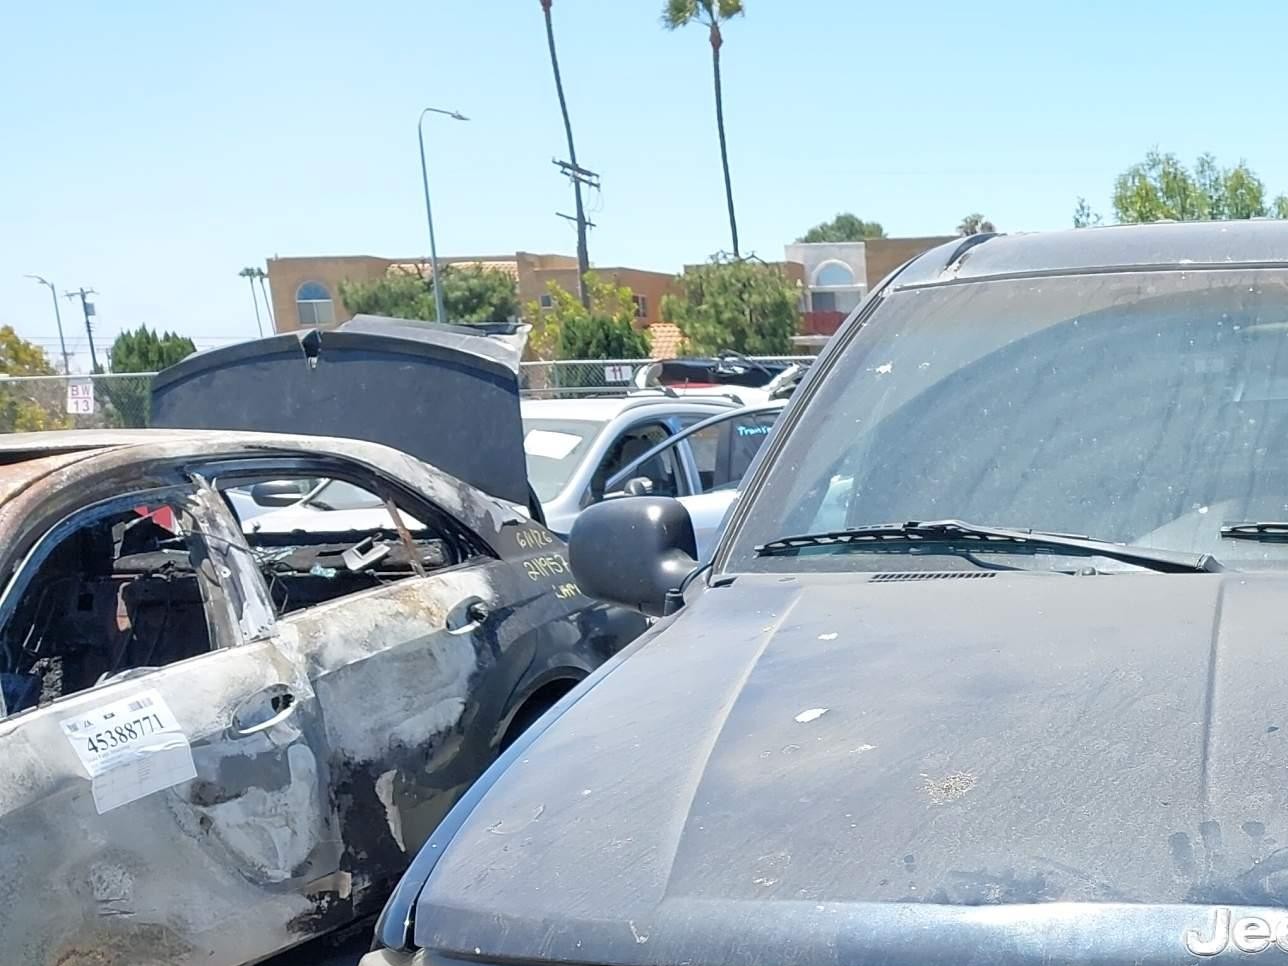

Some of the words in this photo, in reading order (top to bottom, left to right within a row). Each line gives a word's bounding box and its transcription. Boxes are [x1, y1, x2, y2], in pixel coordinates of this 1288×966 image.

[612, 366, 624, 380] 11
[73, 399, 90, 411] 13
[87, 713, 164, 753] 45388771
